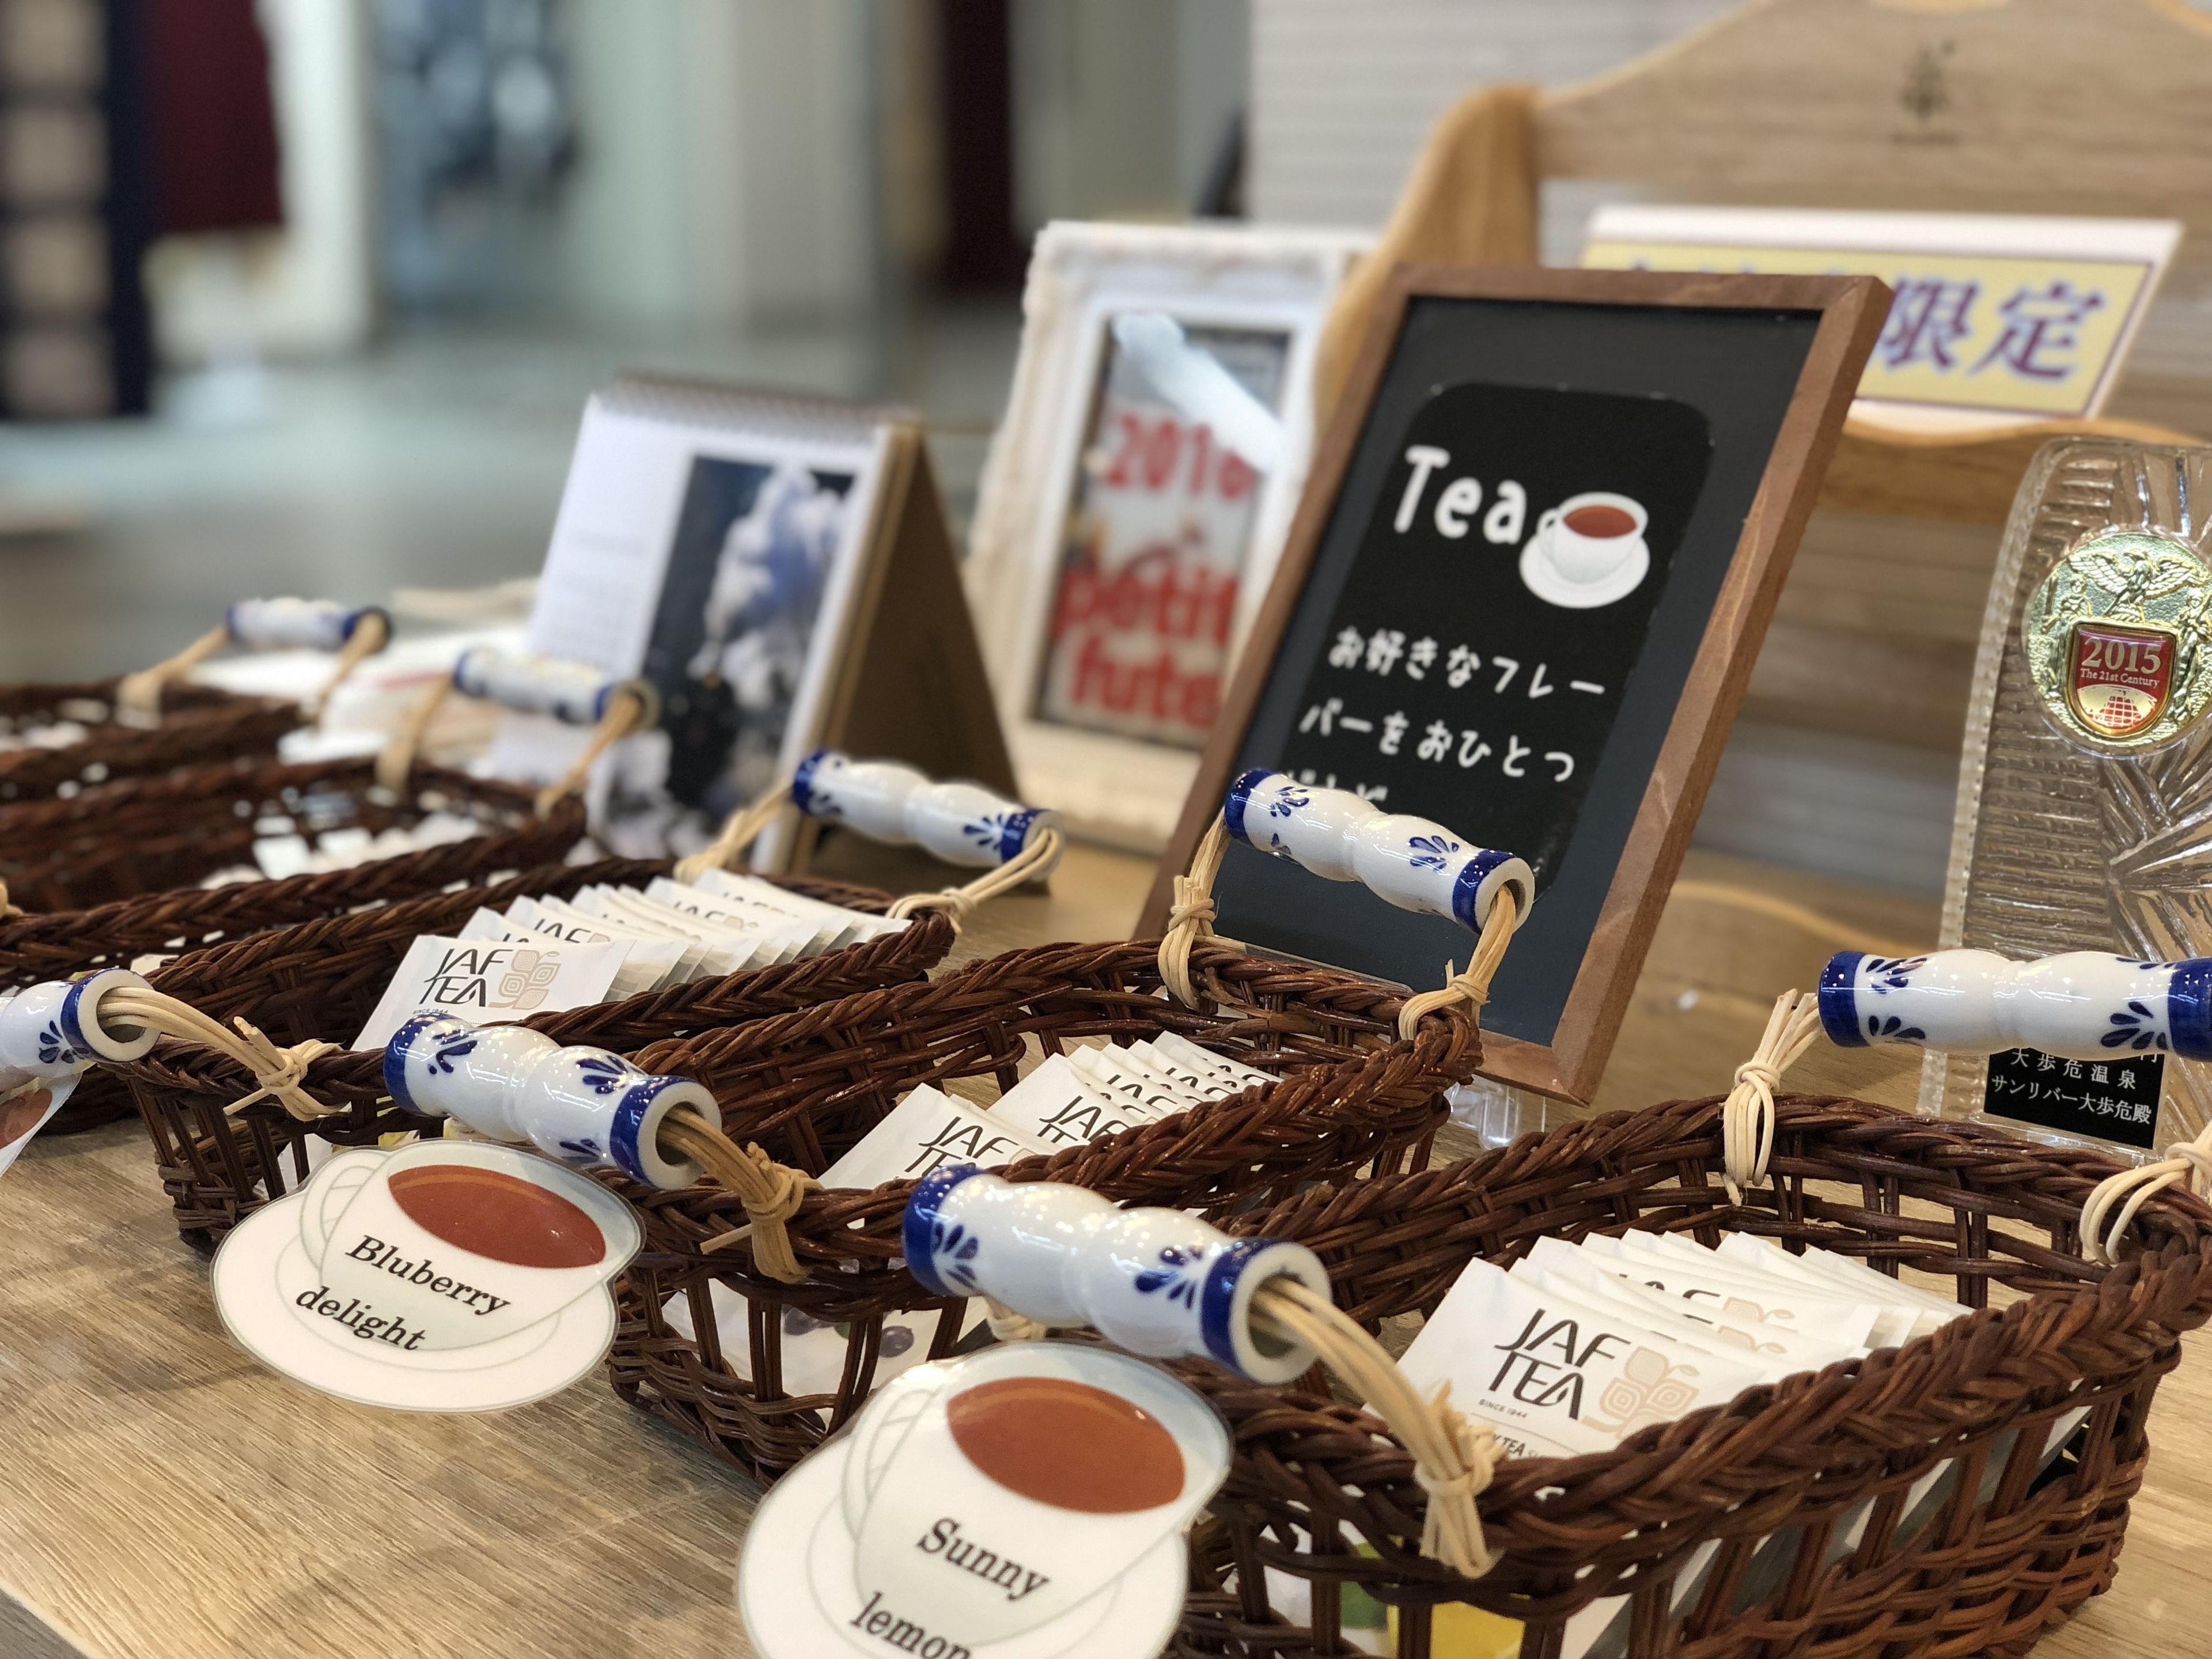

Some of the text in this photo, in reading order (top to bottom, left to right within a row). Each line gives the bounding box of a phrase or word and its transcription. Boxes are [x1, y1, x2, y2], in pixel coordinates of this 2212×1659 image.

[1394, 445, 1527, 544] Tea
[1328, 626, 1605, 699] お好きなフレー
[2080, 668, 2160, 689] The 21st Century
[2082, 637, 2162, 674] 2015
[419, 975, 486, 1007] TEA
[424, 948, 514, 983] JAF
[1992, 1075, 2152, 1124] サンリバー大歩危殿
[918, 1116, 1019, 1159] JAF
[345, 1234, 511, 1316] Bluberry
[296, 1286, 426, 1351] delight
[1494, 1308, 1631, 1368] JAF
[1479, 1399, 1506, 1412] SINCE
[1488, 1350, 1584, 1420] TEA
[916, 1517, 1050, 1601] Sunny
